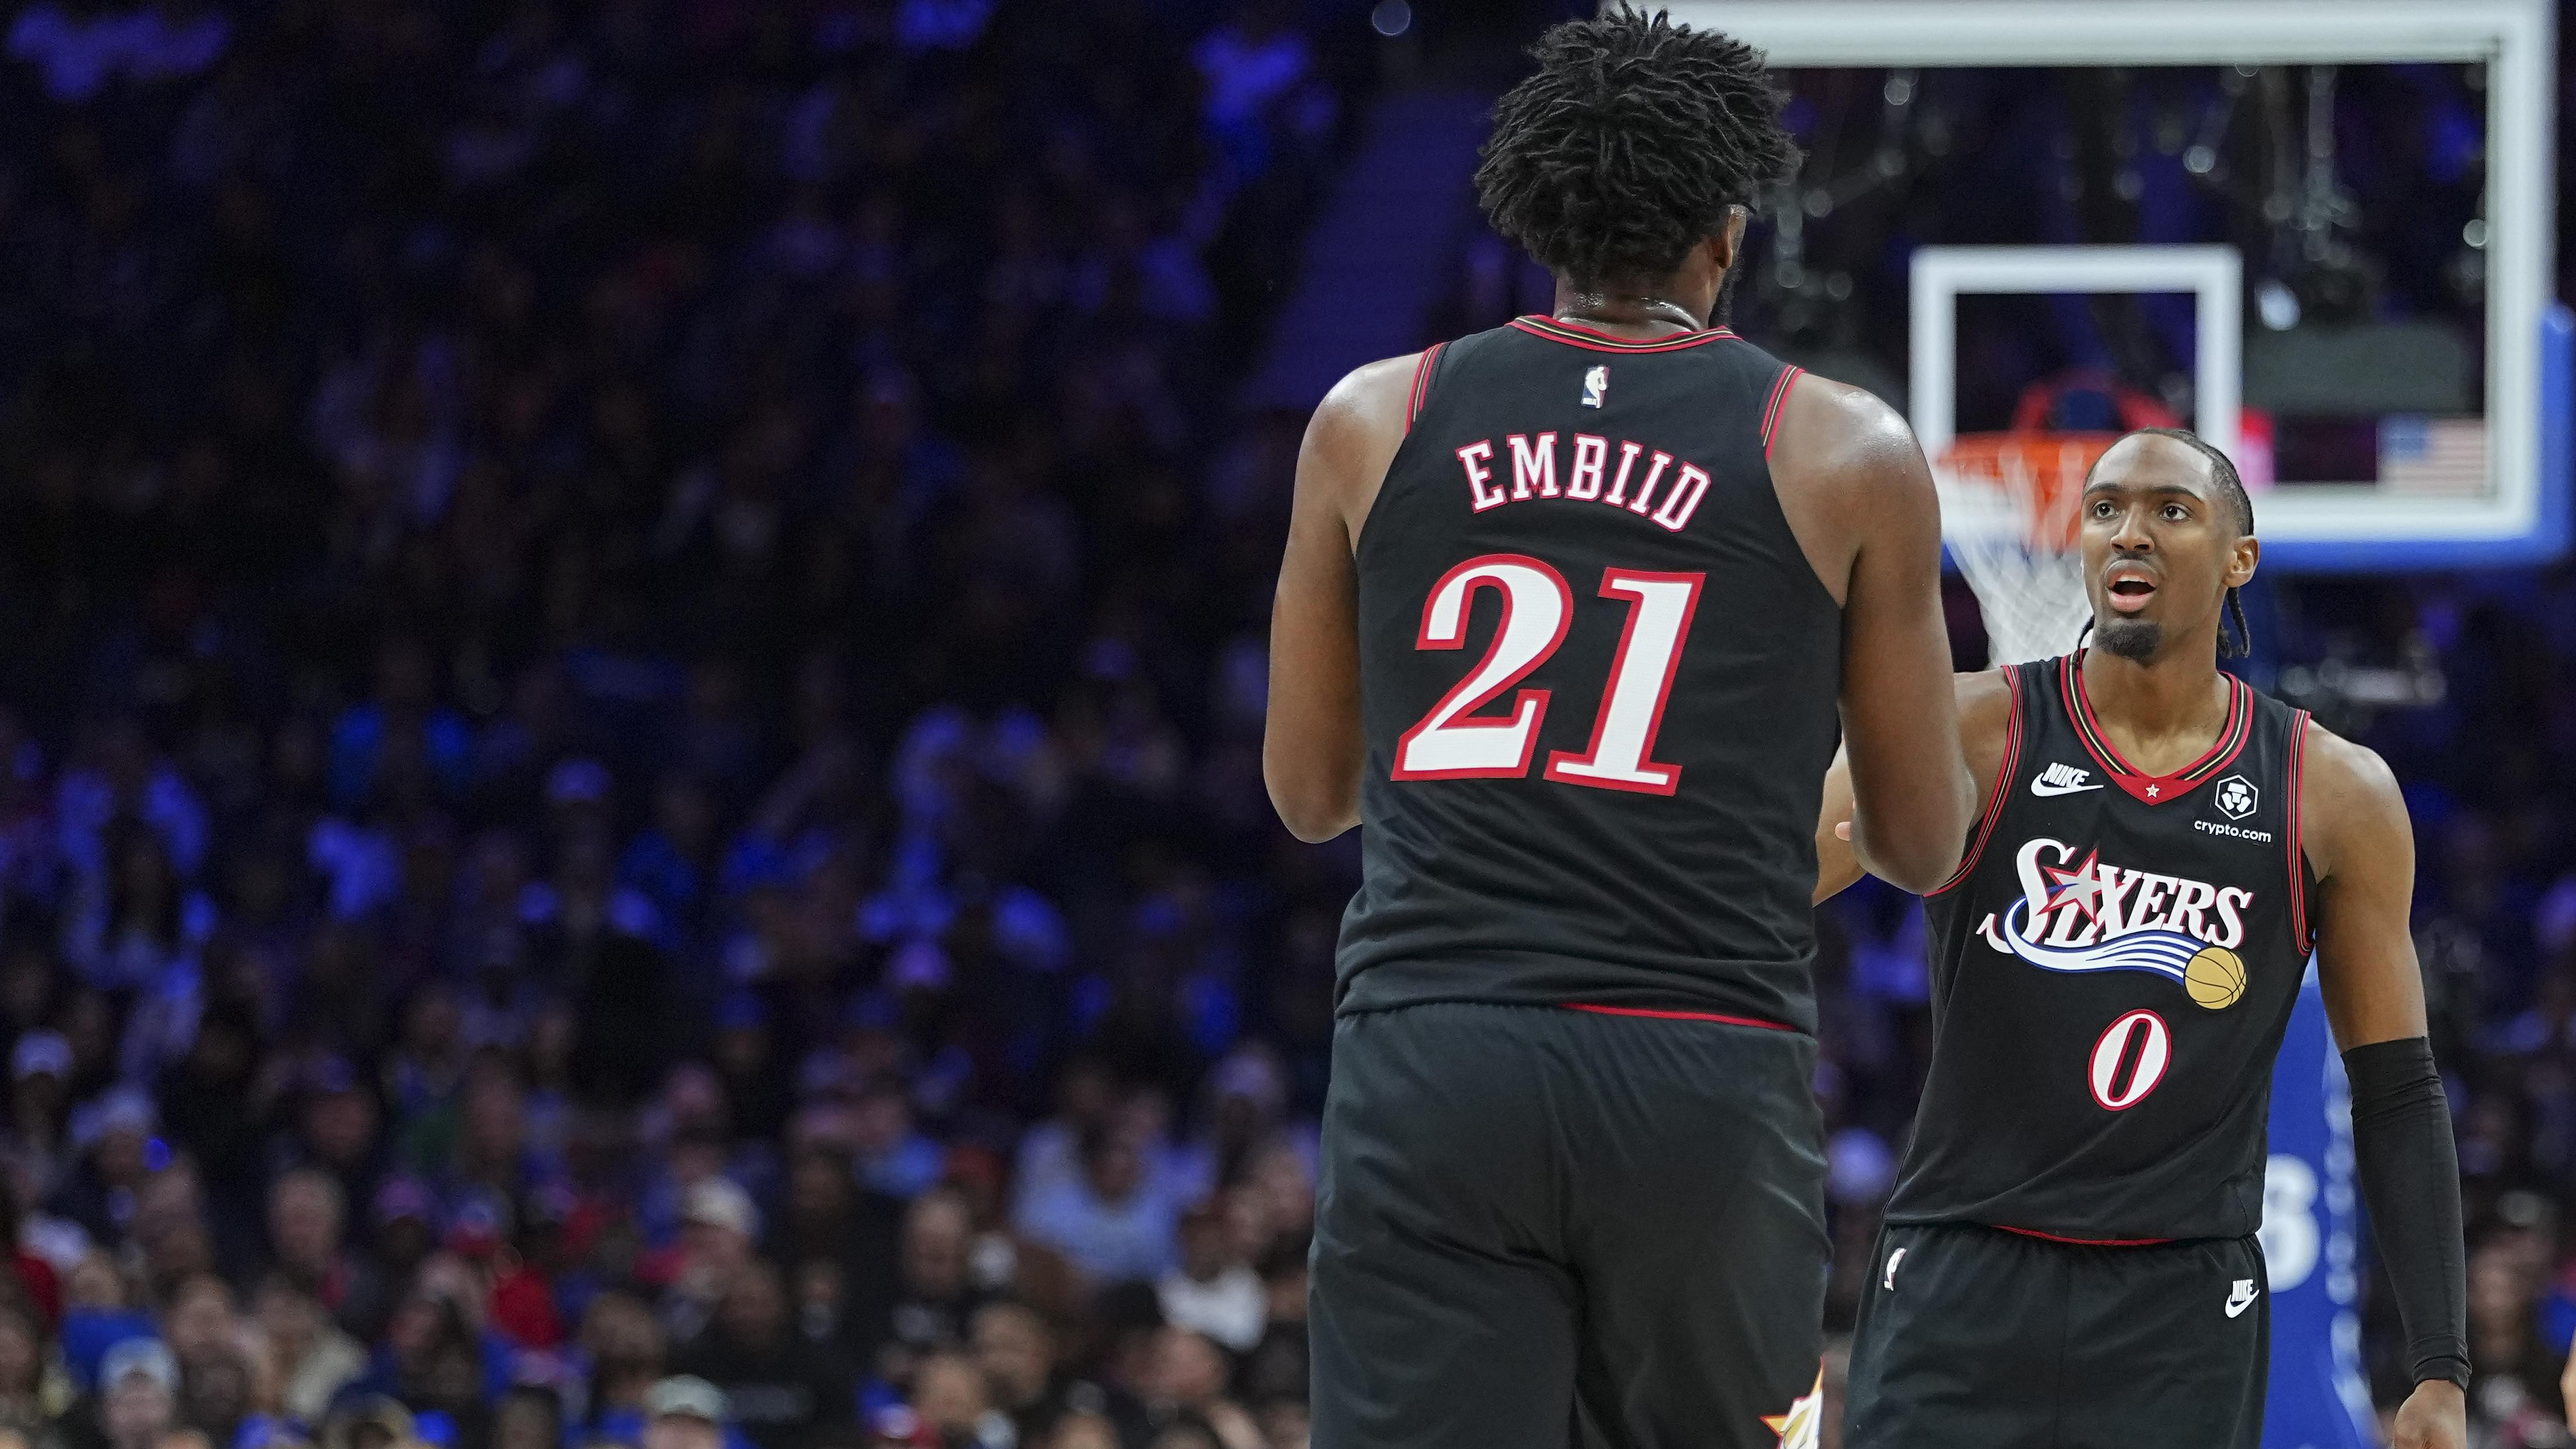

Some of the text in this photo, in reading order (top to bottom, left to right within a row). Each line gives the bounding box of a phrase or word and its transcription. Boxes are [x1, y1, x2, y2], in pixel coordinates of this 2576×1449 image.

[1455, 431, 1711, 532] EMBIID
[1390, 554, 1706, 796] 21
[2042, 763, 2090, 787] NIKE
[2194, 820, 2271, 842] crypto.com
[1976, 838, 2254, 954] SIXERS
[2088, 1009, 2172, 1111] 0
[2231, 1279, 2253, 1302] NIKE
